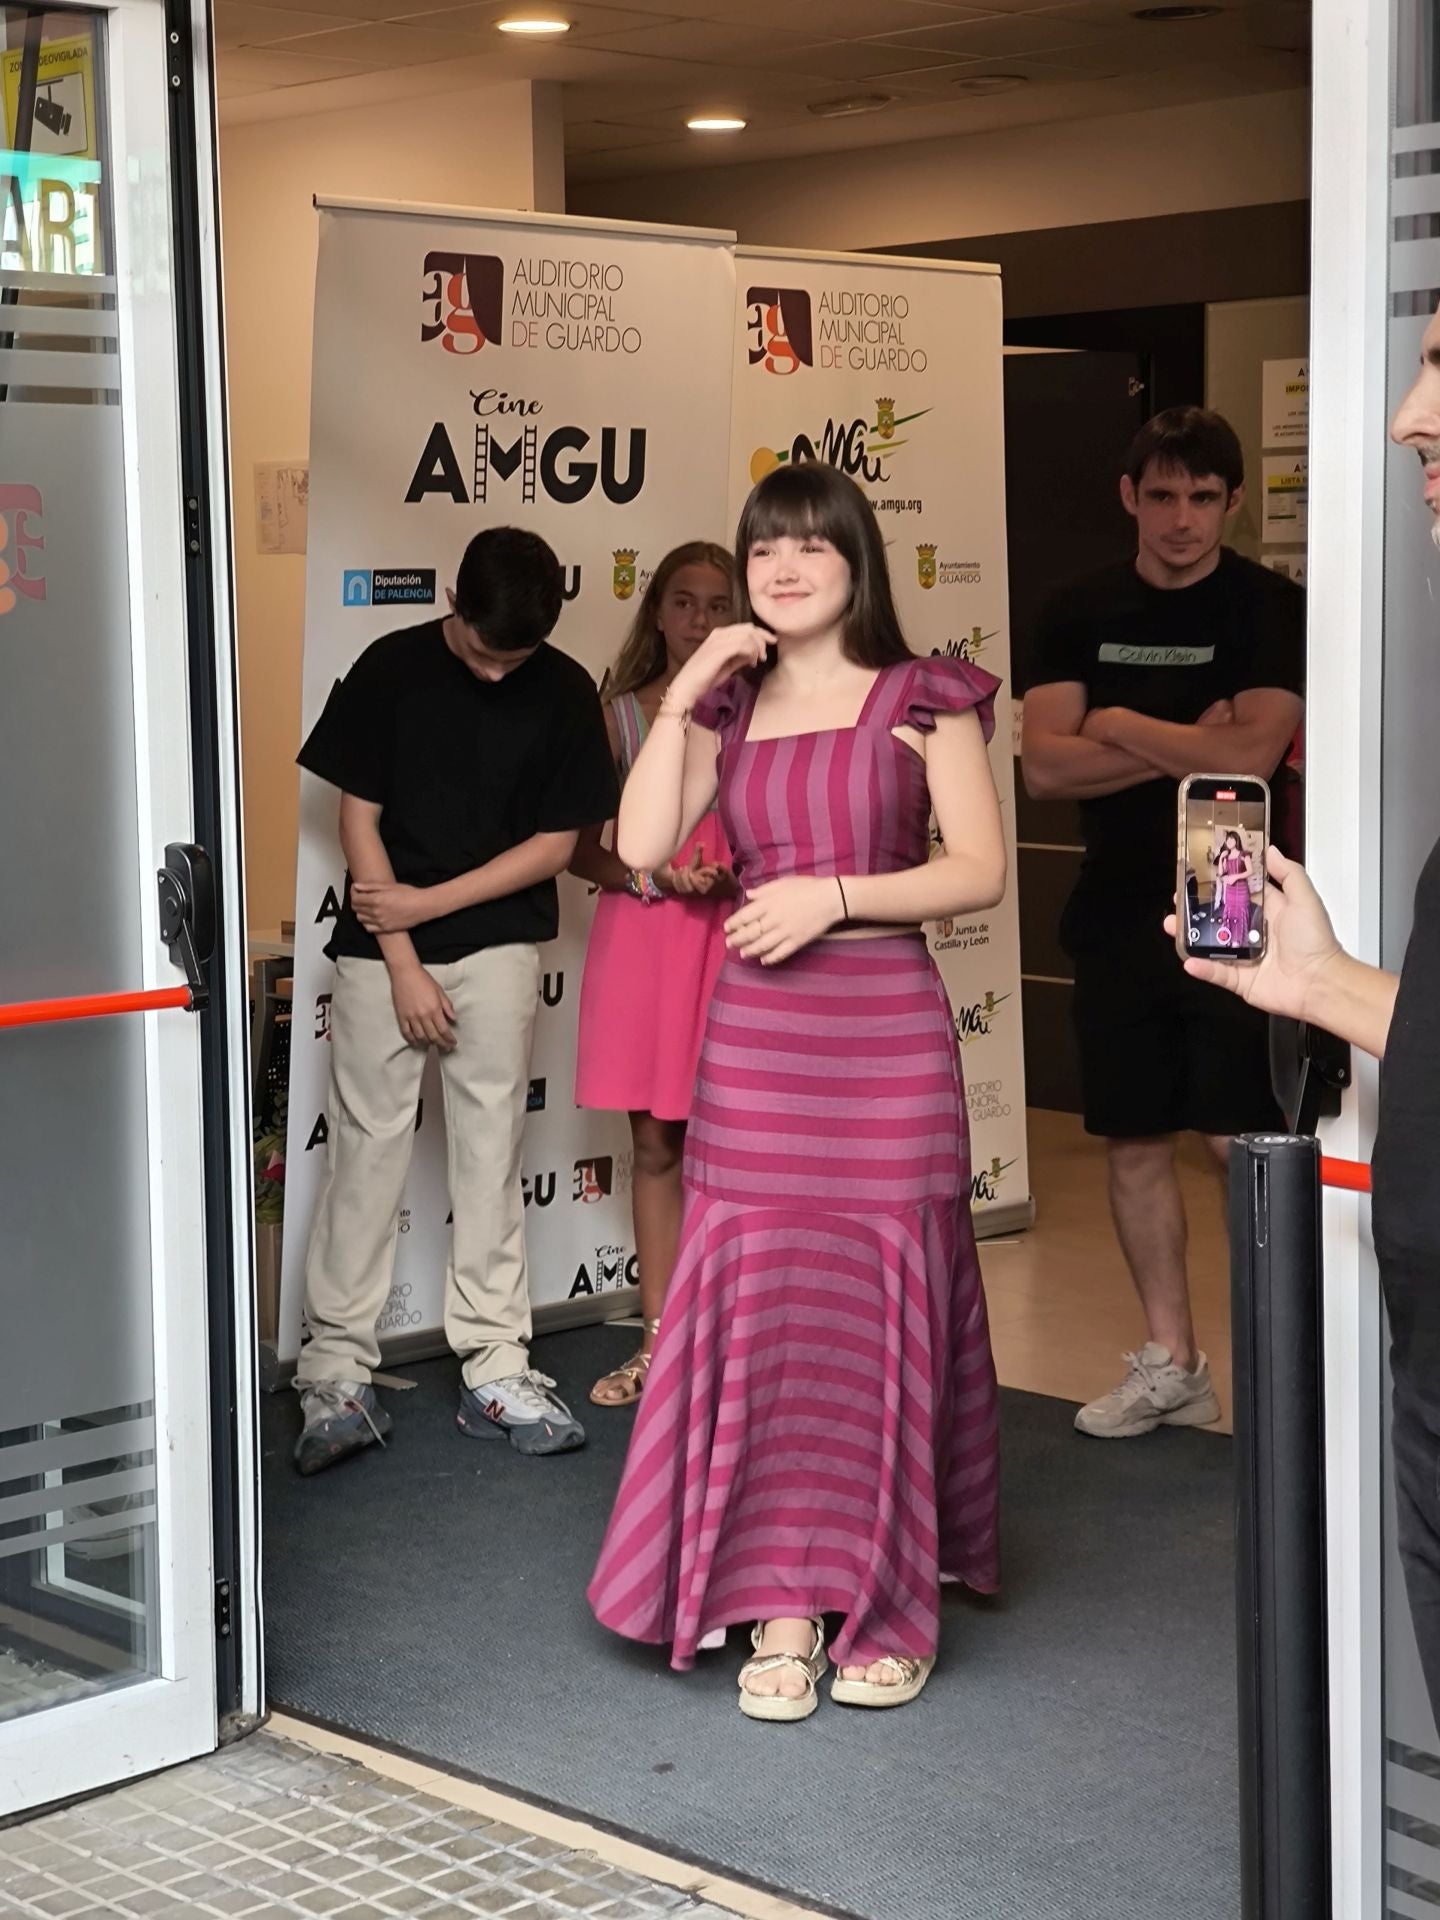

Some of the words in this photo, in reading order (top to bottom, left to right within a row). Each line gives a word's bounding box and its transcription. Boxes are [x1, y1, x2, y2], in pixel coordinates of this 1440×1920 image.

[38, 47, 88, 67] DEOVIGILADA
[512, 258, 623, 291] AUDITORIO
[511, 290, 615, 322] MUNICIPAL
[818, 291, 909, 319] AUDITORIO
[512, 321, 538, 348] DE
[546, 322, 642, 353] GUARDO
[819, 319, 905, 345] MUNICIPAL
[820, 345, 842, 369] DE
[848, 346, 928, 373] GUARDO
[469, 388, 544, 417] Cine
[403, 421, 647, 505] AMGU
[939, 561, 981, 571] Ayuntamiento
[375, 574, 422, 588] Diputación
[939, 574, 981, 584] GUARDO
[374, 589, 386, 600] DE
[387, 588, 433, 600] PALENCIA
[954, 926, 977, 937] Junta
[979, 924, 989, 933] de
[934, 938, 961, 951] Castilla
[963, 940, 969, 950] y
[970, 936, 989, 946] León
[594, 1245, 626, 1258] Cine
